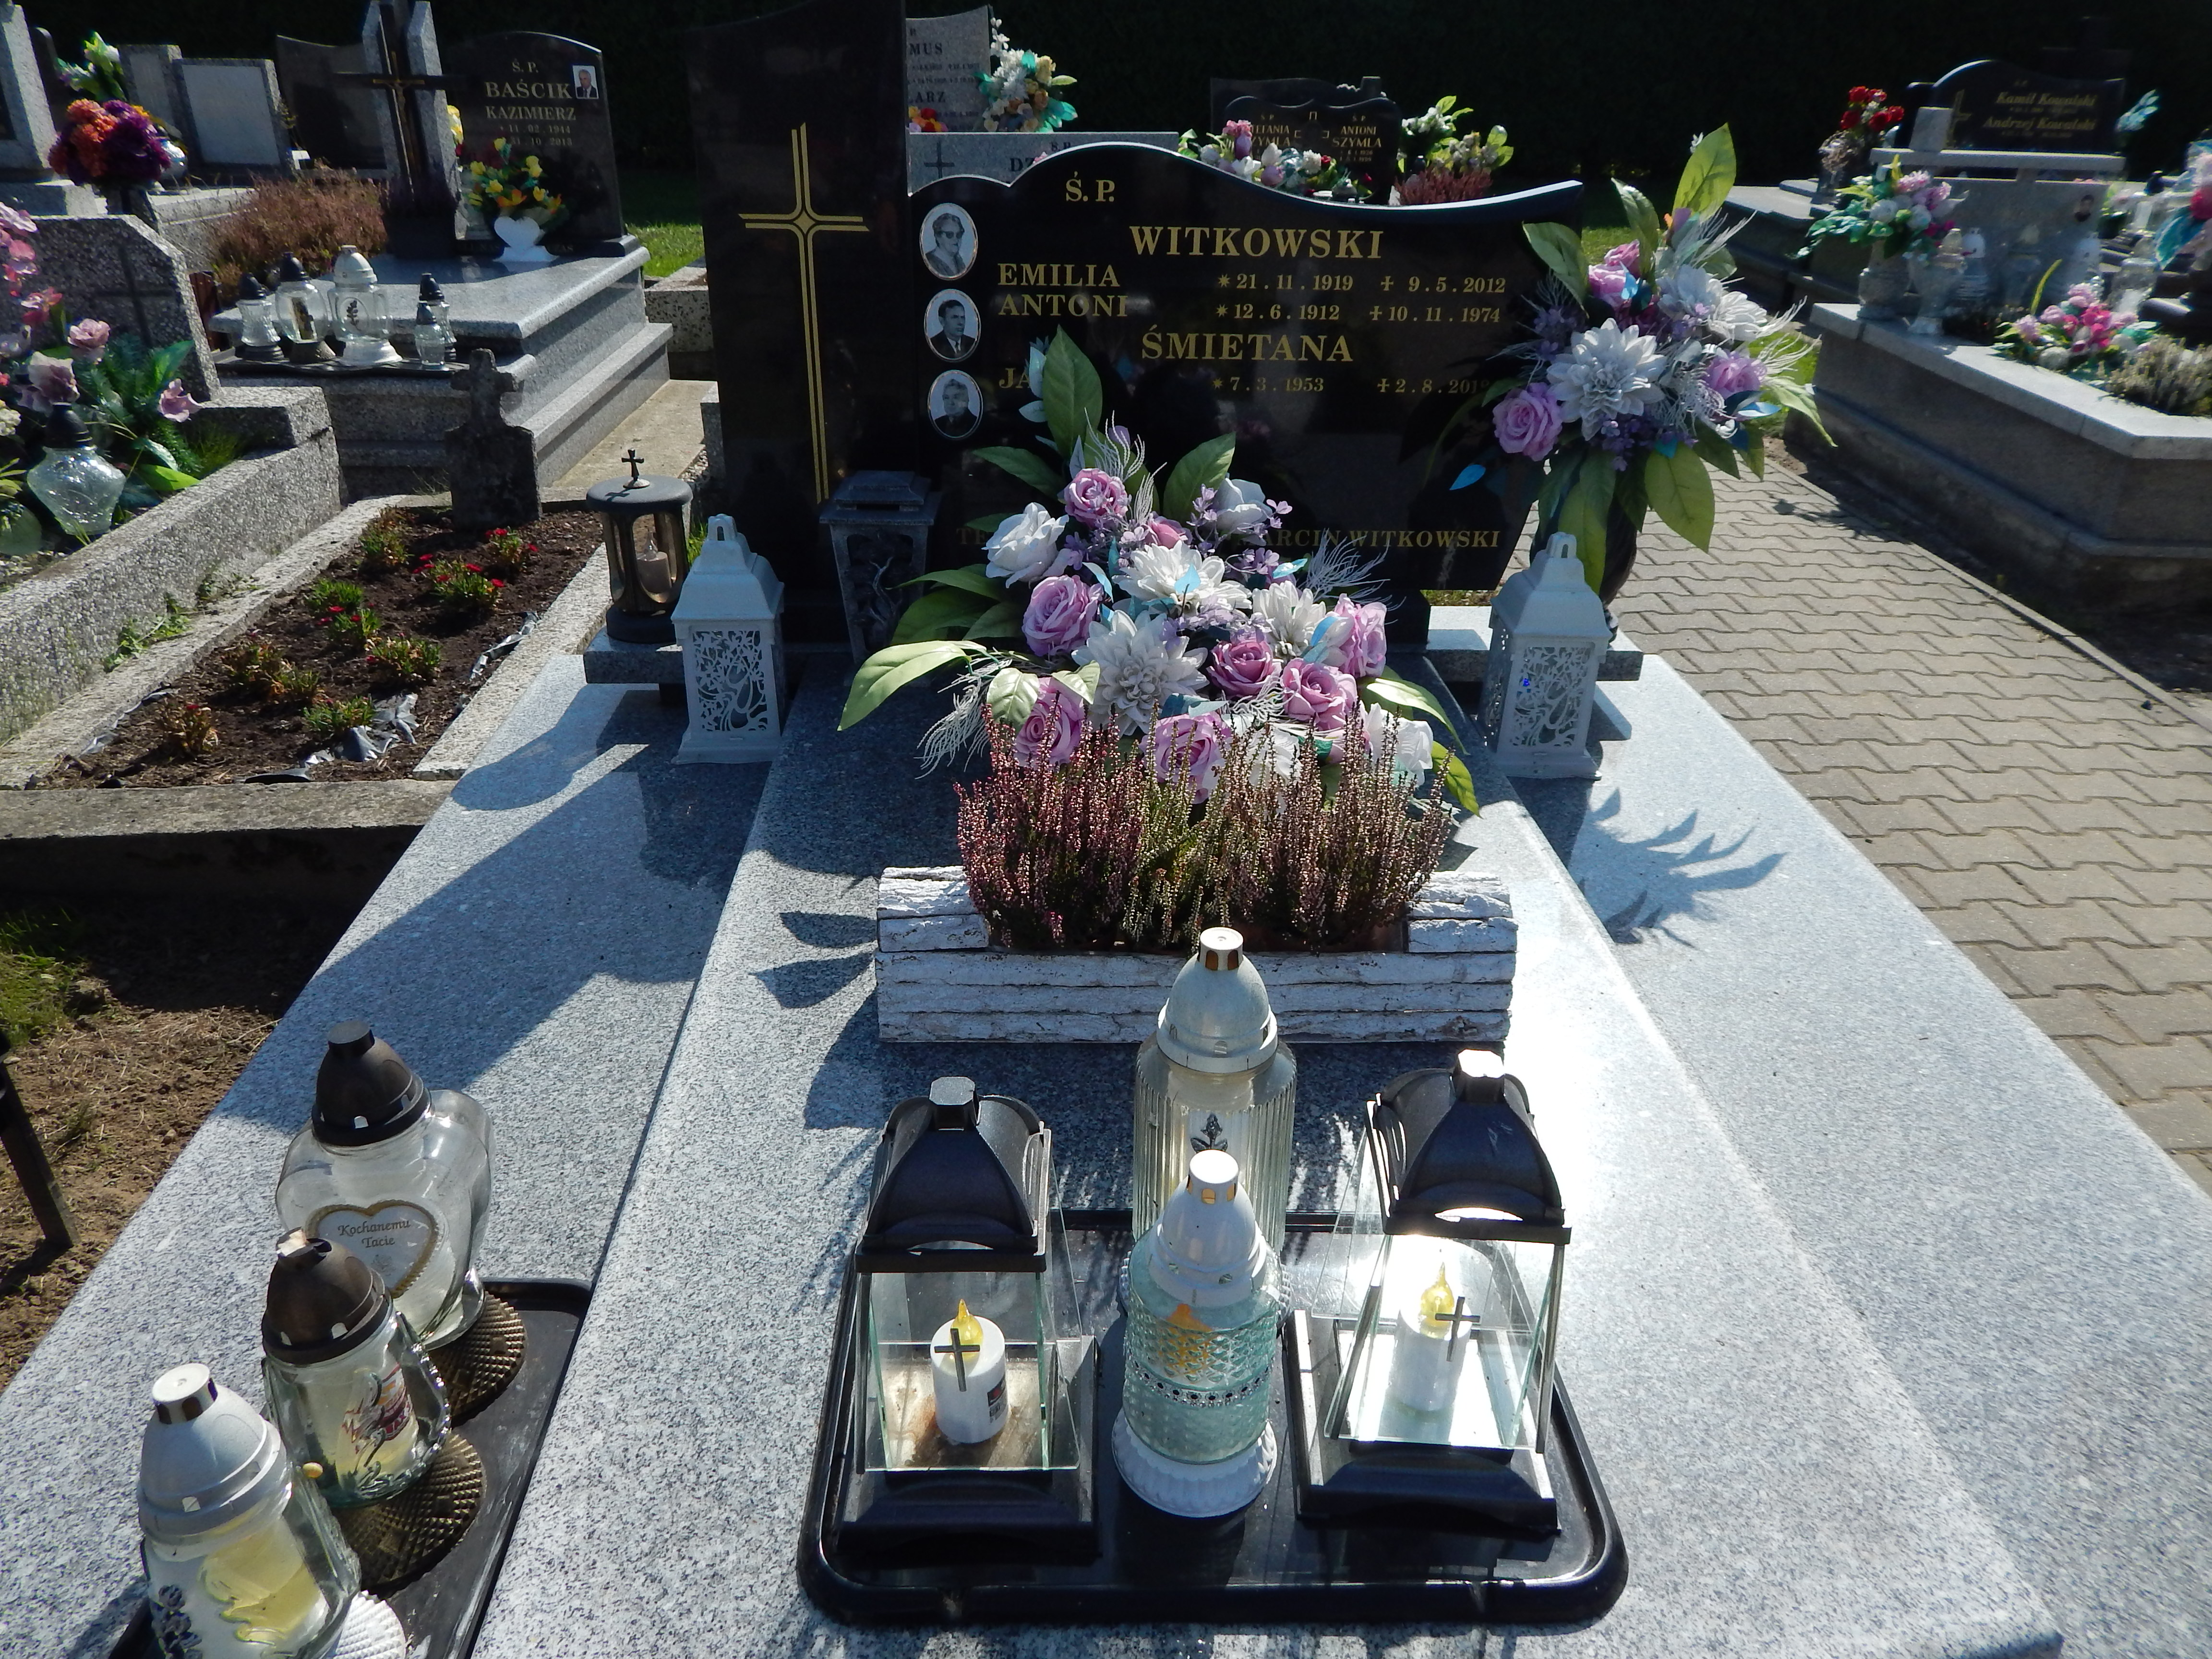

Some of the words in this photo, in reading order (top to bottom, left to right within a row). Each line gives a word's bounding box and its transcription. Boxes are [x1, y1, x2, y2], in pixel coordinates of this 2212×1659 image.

[485, 79, 573, 99] BAŚCIK
[486, 106, 576, 120] KAZIMIERZ
[1340, 125, 1376, 135] ANTONI
[1130, 226, 1383, 259] WITKOWSKI
[998, 263, 1120, 287] EMILIA
[998, 294, 1128, 317] ANTONI
[1142, 324, 1353, 361] ŚMIETANA
[1349, 529, 1501, 548] WITKOWSKI
[338, 1220, 411, 1237] Kochanemu
[362, 1236, 396, 1248] Tacie
